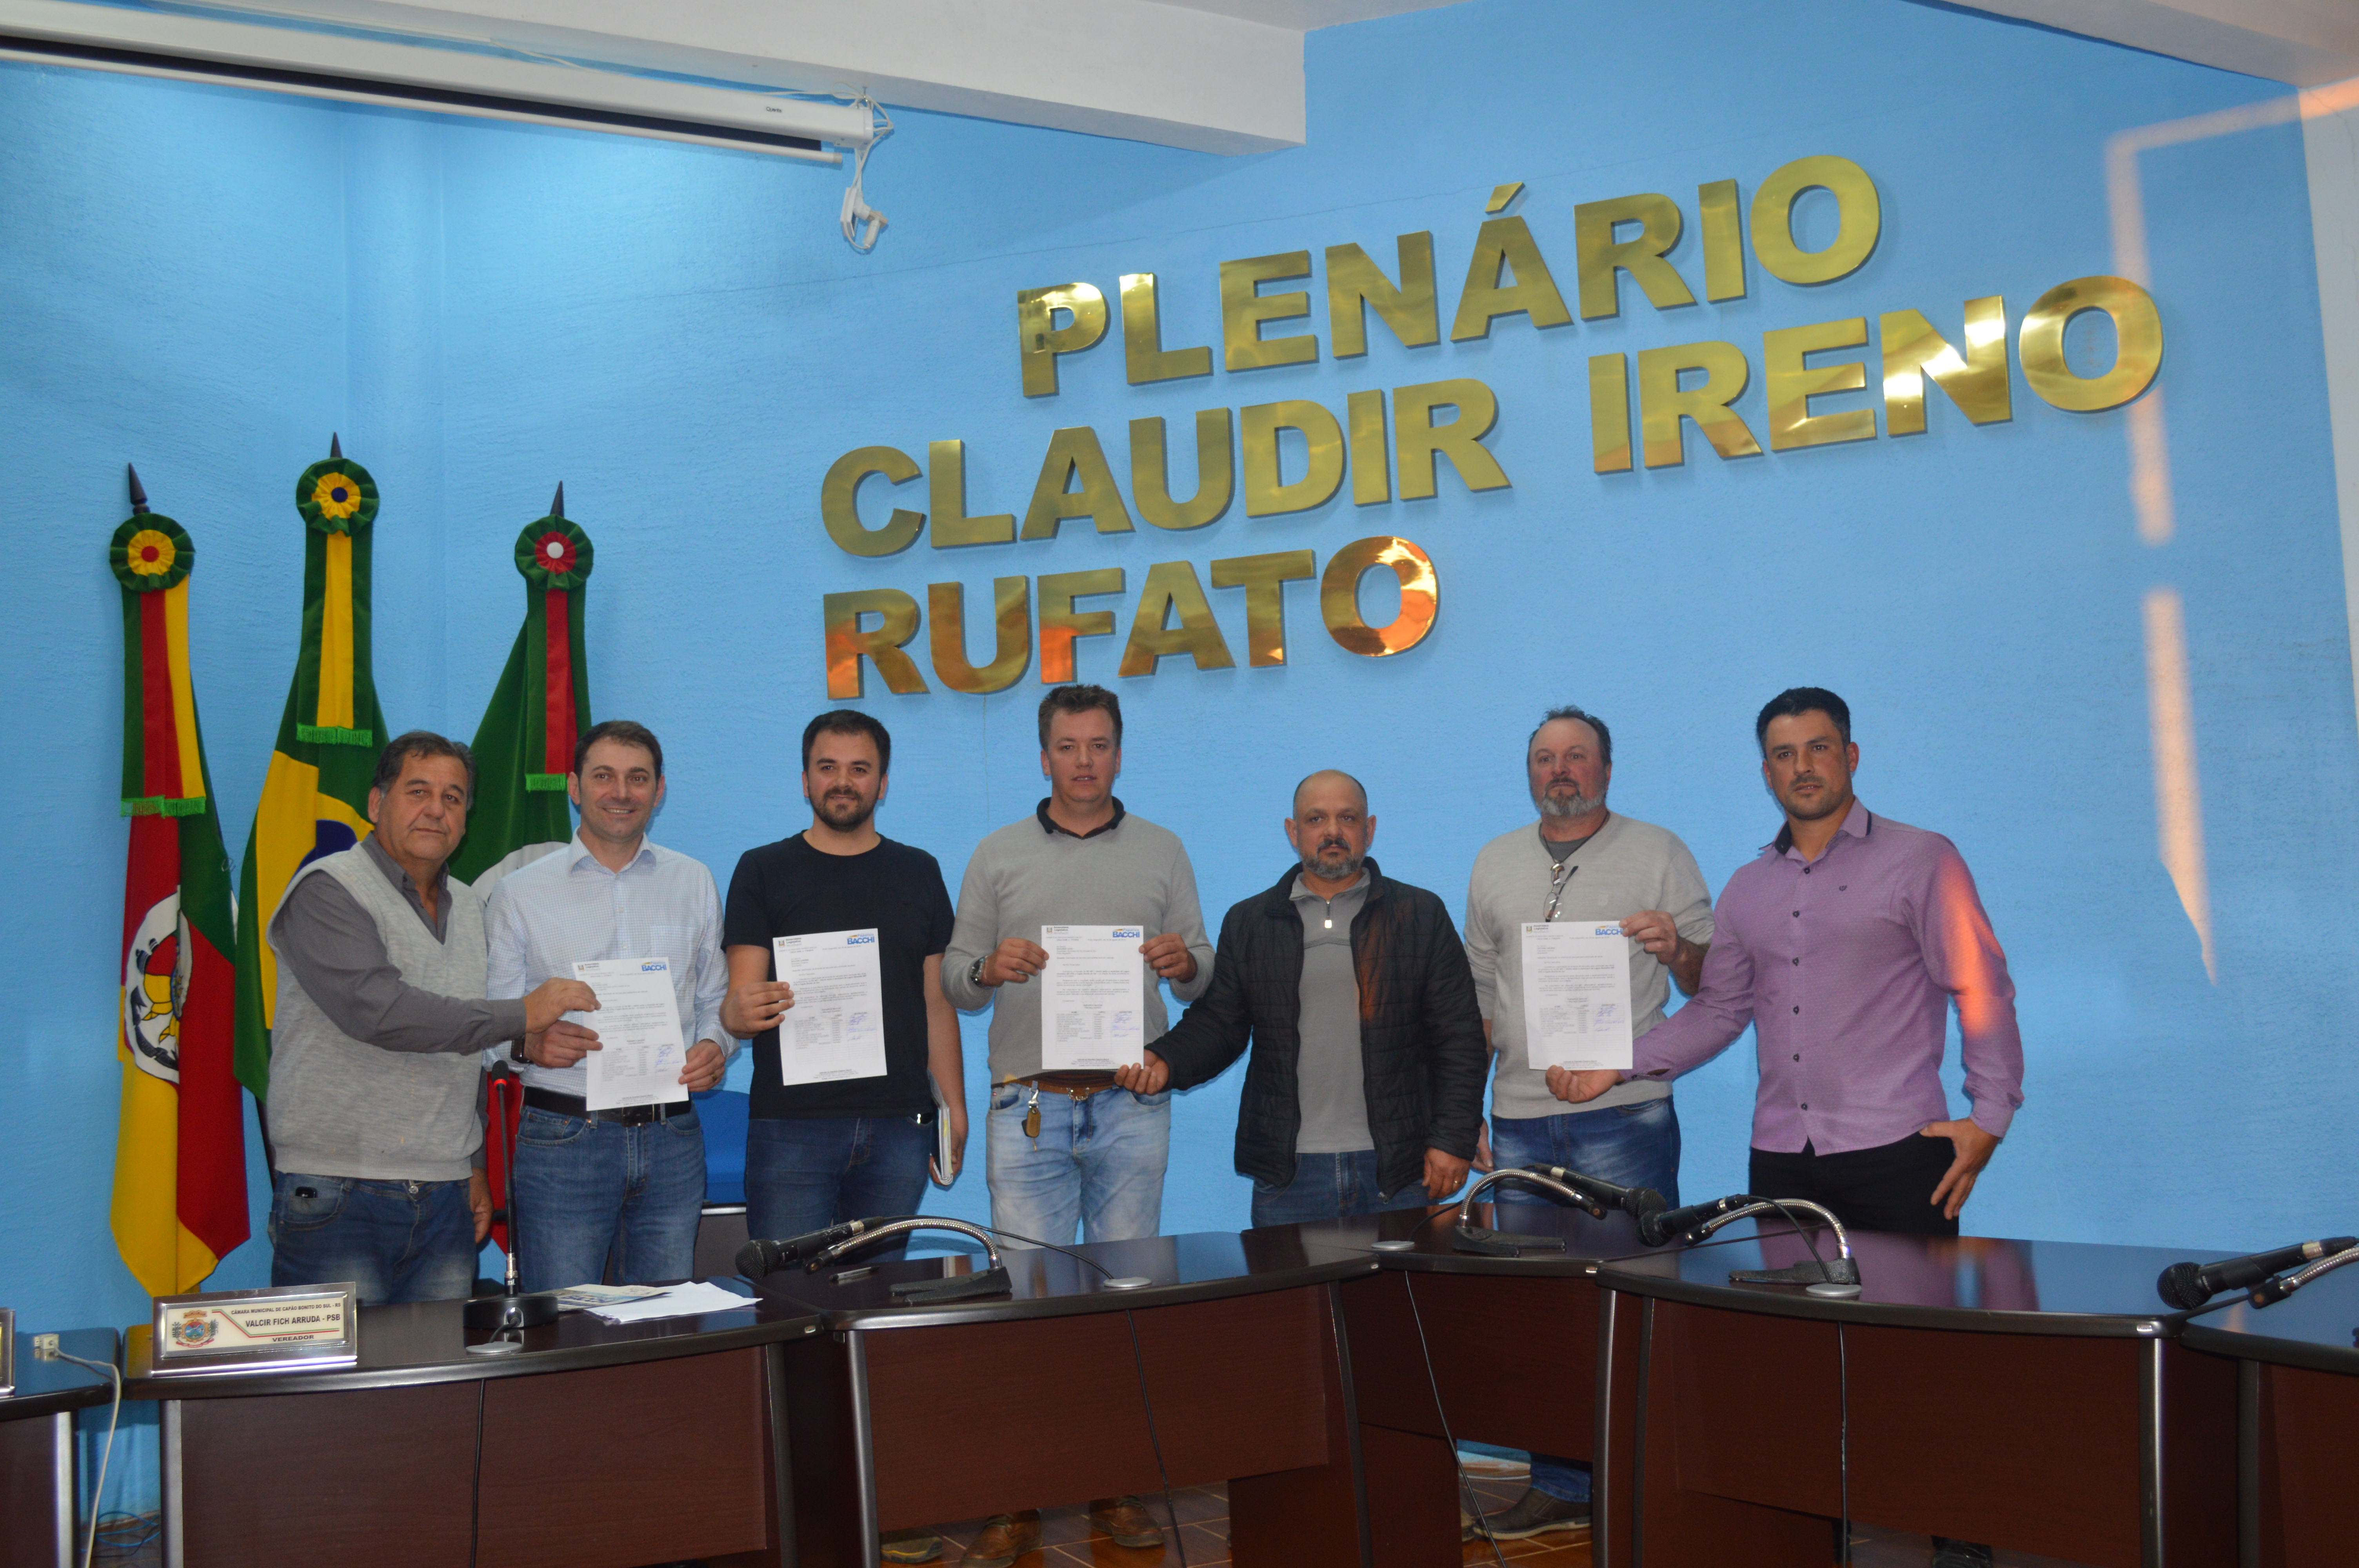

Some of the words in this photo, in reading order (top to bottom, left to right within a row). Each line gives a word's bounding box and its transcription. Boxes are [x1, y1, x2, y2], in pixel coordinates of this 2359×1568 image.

[1018, 155, 1881, 397] PLENÁRIO
[820, 378, 1511, 557] CLAUDIR
[1588, 274, 2163, 474] IRENO
[823, 535, 1438, 700] RUFATO
[847, 936, 875, 945] BACCHI
[246, 1319, 271, 1327] VALCIR
[292, 1315, 320, 1324] ARRUDA
